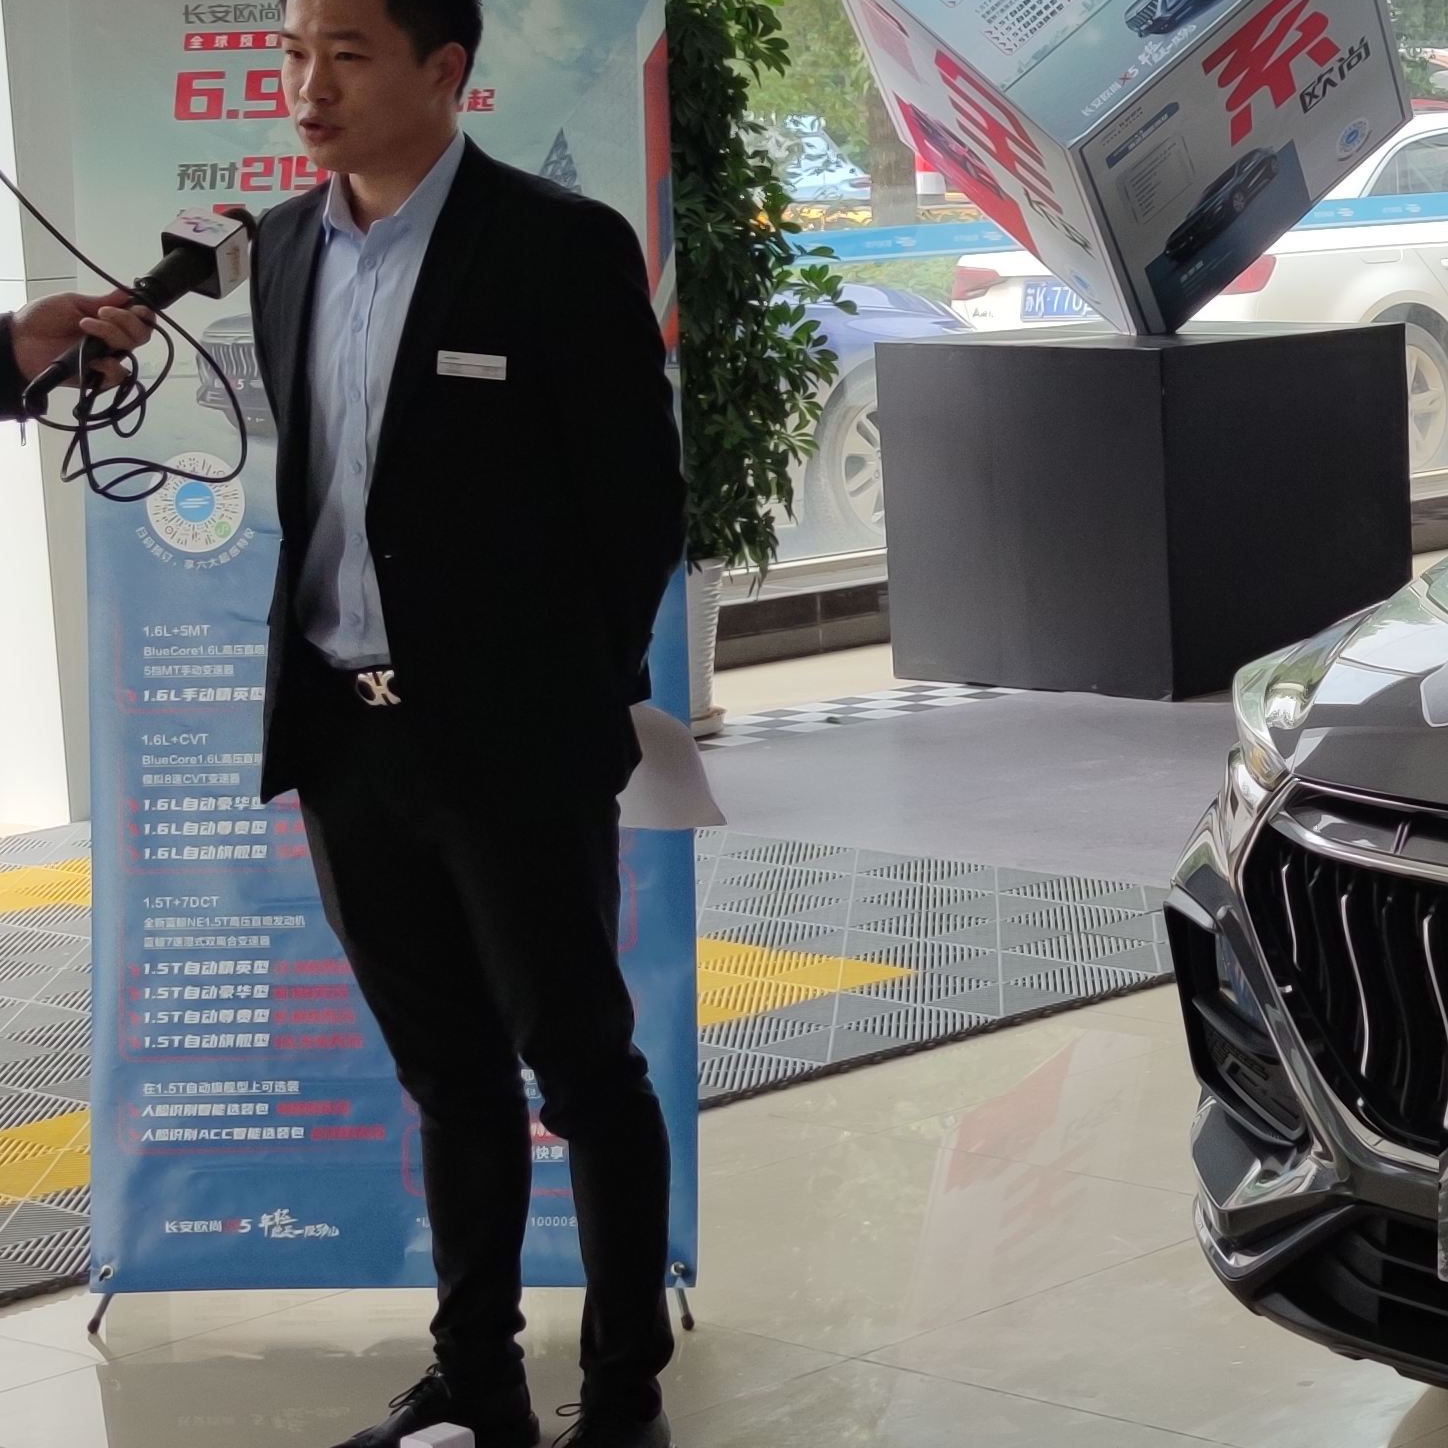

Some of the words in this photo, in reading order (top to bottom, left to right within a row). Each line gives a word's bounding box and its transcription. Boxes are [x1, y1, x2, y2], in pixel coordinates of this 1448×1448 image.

[182, 3, 281, 25] 长安欧尚
[1300, 35, 1371, 114] 欧尚
[142, 624, 212, 638] 1.6L+5MT
[141, 733, 210, 746] 1.6L+CVT
[142, 896, 221, 909] 1.5T+7DCT
